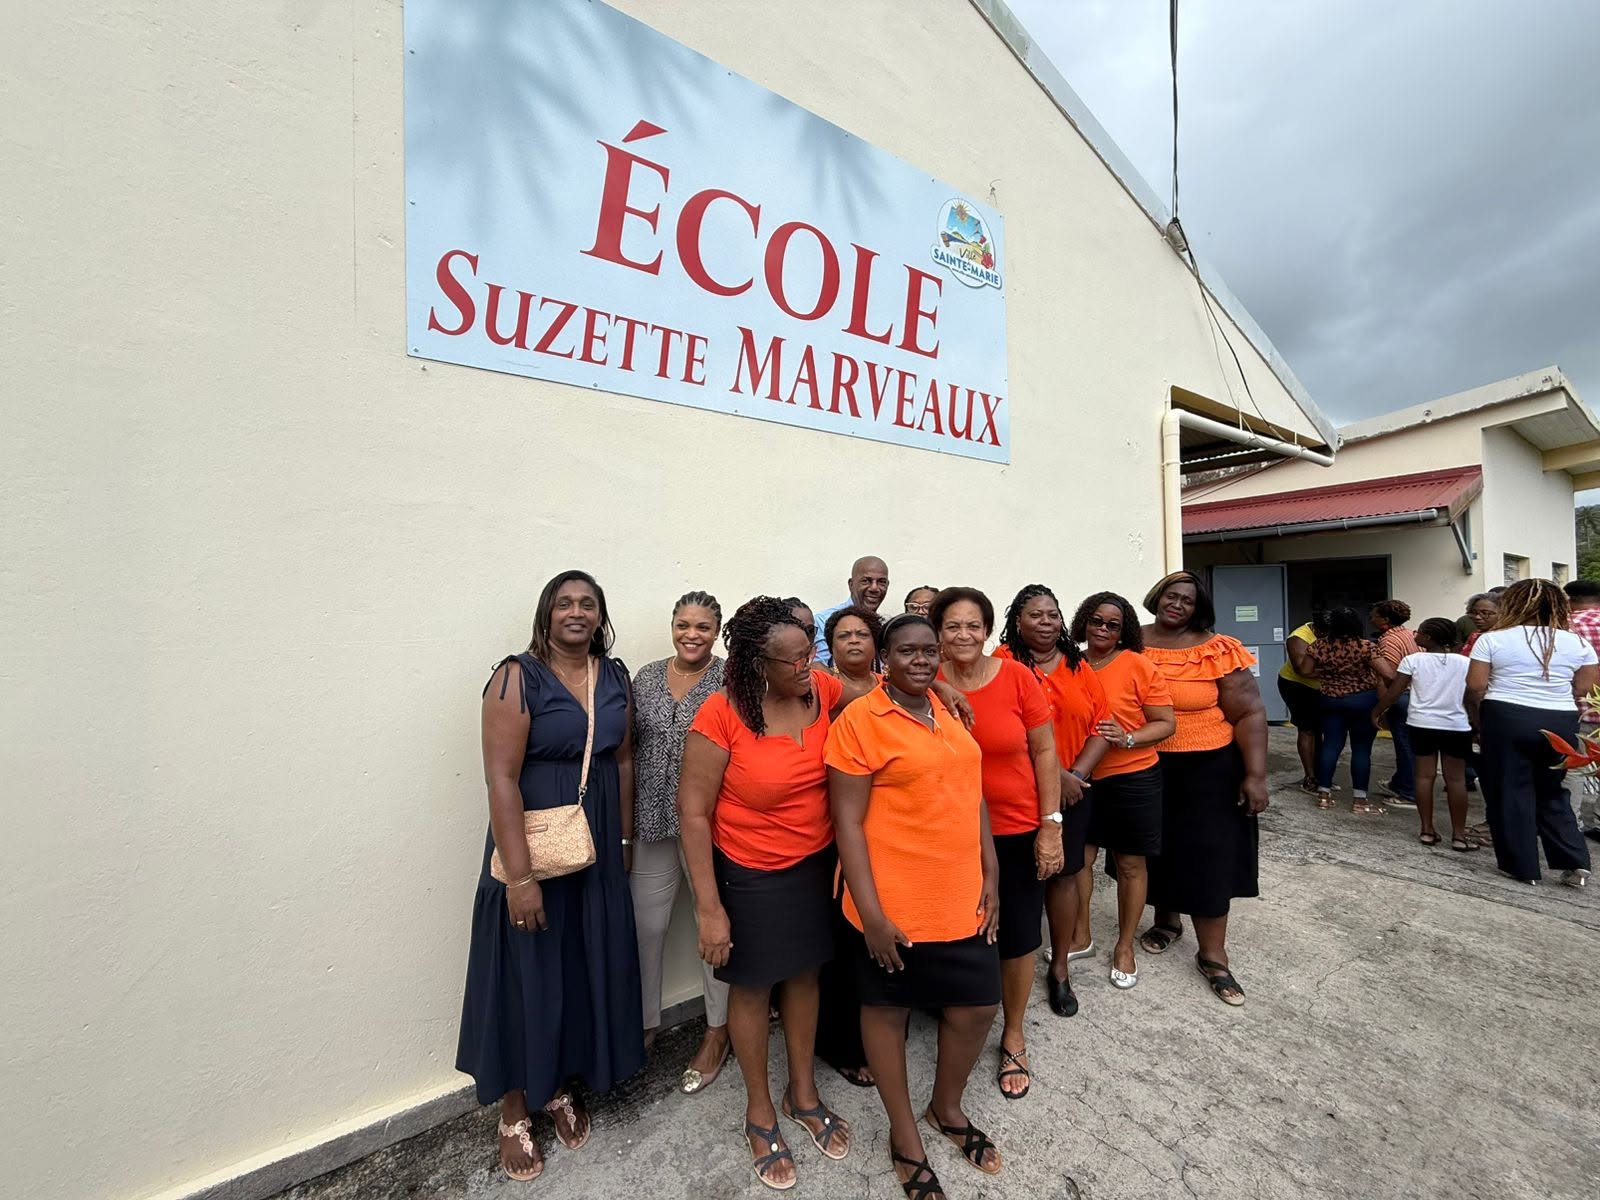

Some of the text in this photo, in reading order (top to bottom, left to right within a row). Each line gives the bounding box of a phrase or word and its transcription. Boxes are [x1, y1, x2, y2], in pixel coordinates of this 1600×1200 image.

[580, 119, 943, 359] ÉCOLE
[933, 248, 999, 285] SAINTE-MARIE
[428, 249, 1002, 447] SUZETTE MARVEAUX
